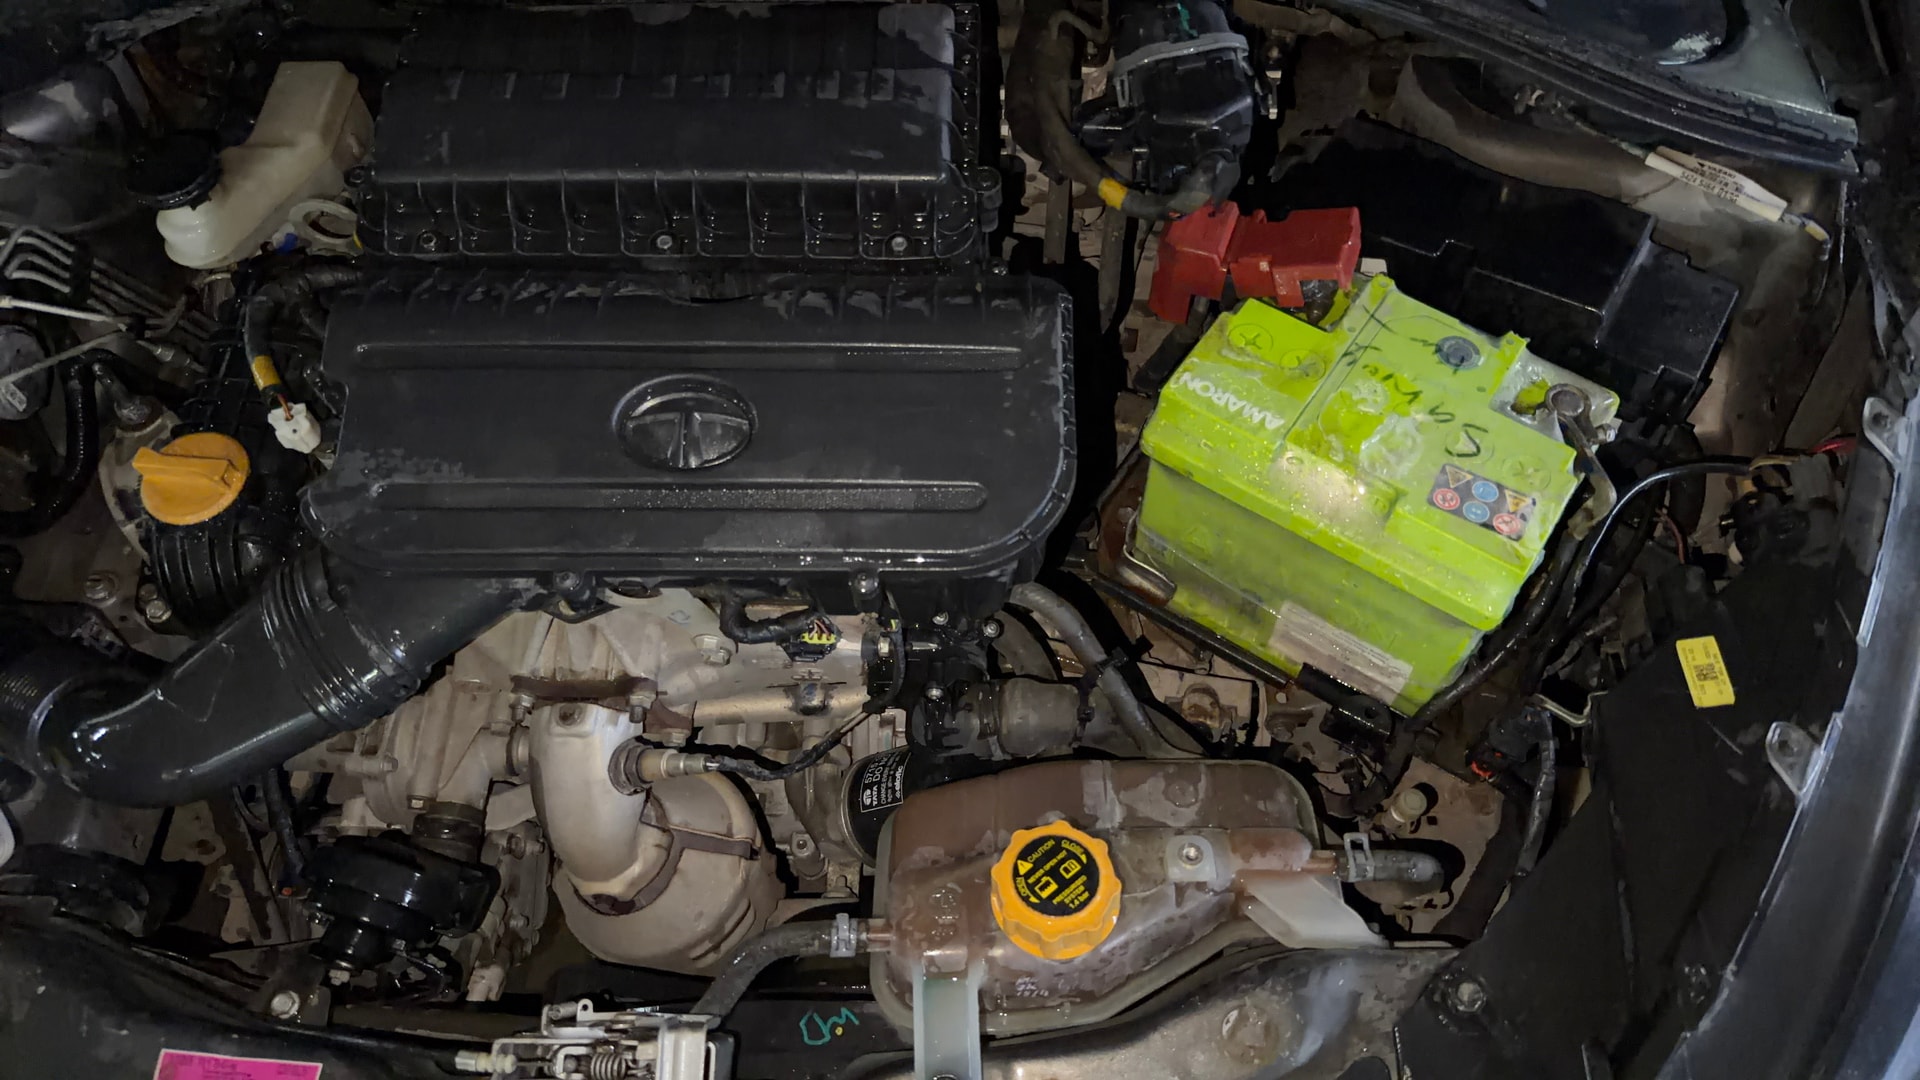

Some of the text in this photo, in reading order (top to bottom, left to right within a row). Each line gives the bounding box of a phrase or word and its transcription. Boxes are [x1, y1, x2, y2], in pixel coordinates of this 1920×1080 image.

[1180, 371, 1285, 430] AMARON
[1027, 838, 1055, 862] CAUTION
[1061, 839, 1084, 854] CLOSE
[1043, 858, 1059, 871] OPEN
[1015, 877, 1028, 896] OPEN
[1069, 898, 1080, 909] 1.4
